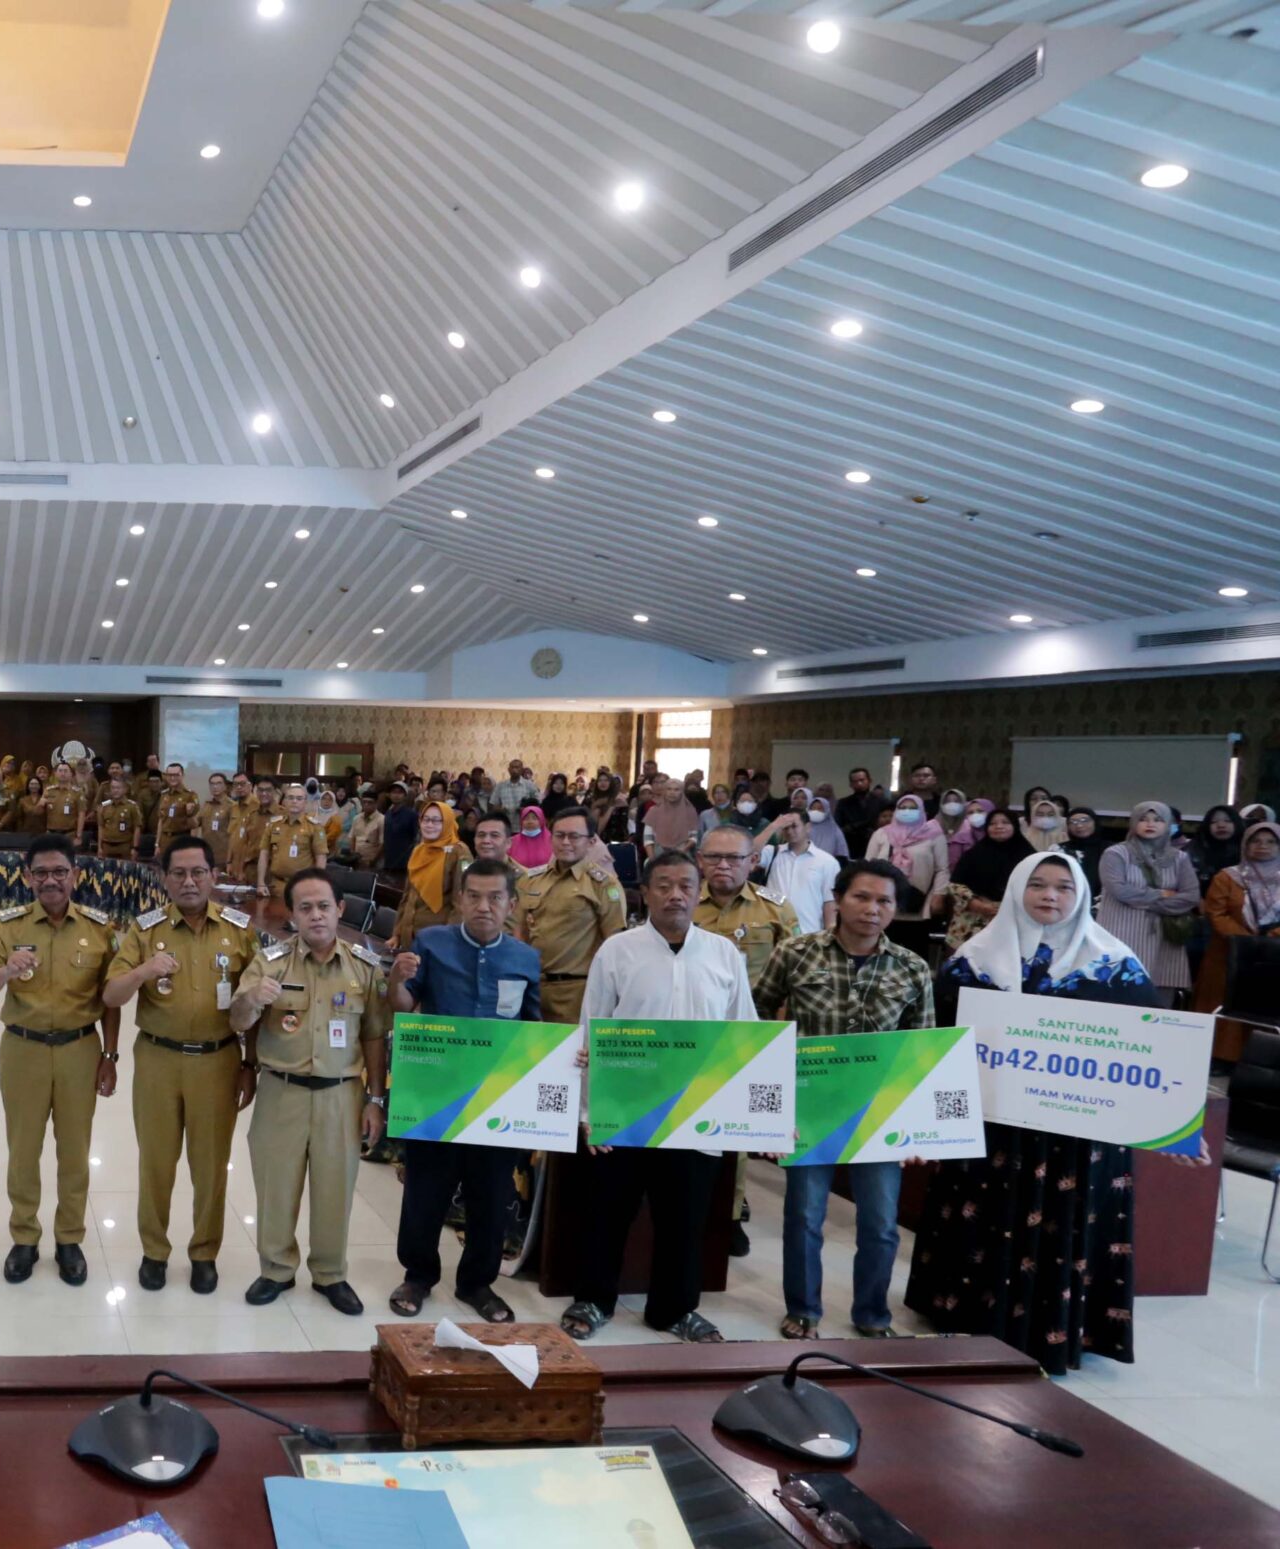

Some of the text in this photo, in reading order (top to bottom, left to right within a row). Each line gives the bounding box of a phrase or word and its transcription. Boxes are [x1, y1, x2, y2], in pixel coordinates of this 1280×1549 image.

[400, 1023, 455, 1032] KARTU PESERTA
[1037, 1017, 1119, 1036] SANTUNAN
[1005, 1026, 1153, 1054] JAMINAN KEMATIAN
[802, 1046, 836, 1054] PESERTA
[975, 1043, 1183, 1094] Rp42.000.000,-
[1025, 1087, 1115, 1108] IMAM WALUYO
[513, 1120, 537, 1128] BPJS
[724, 1122, 750, 1131] BPJS
[913, 1131, 938, 1140] BPJS
